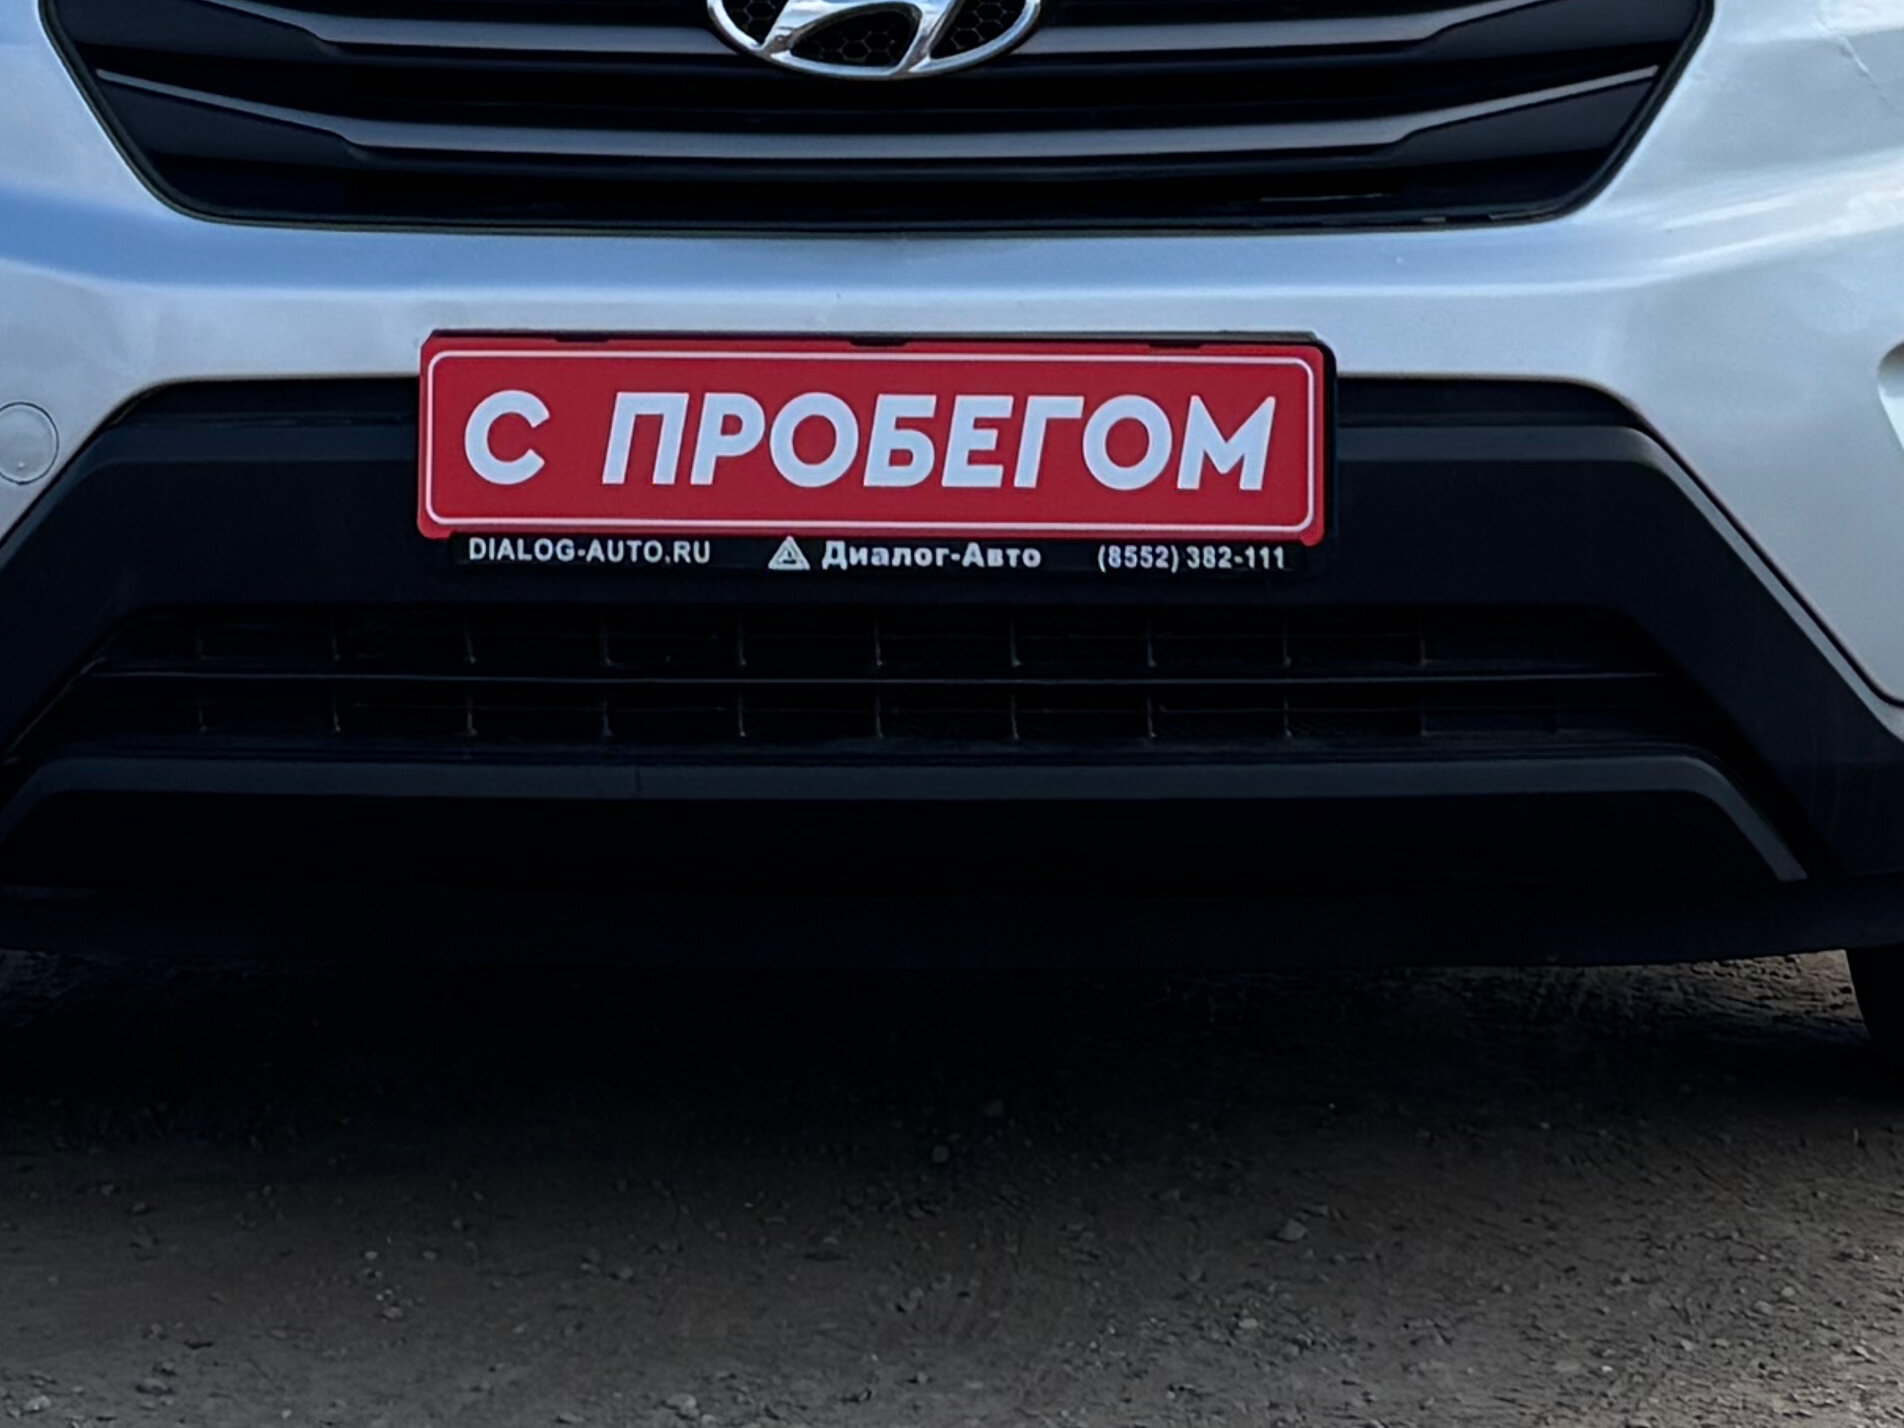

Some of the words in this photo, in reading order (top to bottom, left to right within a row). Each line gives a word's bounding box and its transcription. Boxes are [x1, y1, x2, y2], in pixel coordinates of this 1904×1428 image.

[464, 389, 550, 485] С
[601, 390, 1277, 490] ПРОБЕГОМ
[468, 537, 711, 564] DIALOG-AUTO.RU
[821, 540, 1042, 570] Диалог-Авто
[1097, 544, 1180, 573] (8552)
[1185, 546, 1285, 570] 382-111
